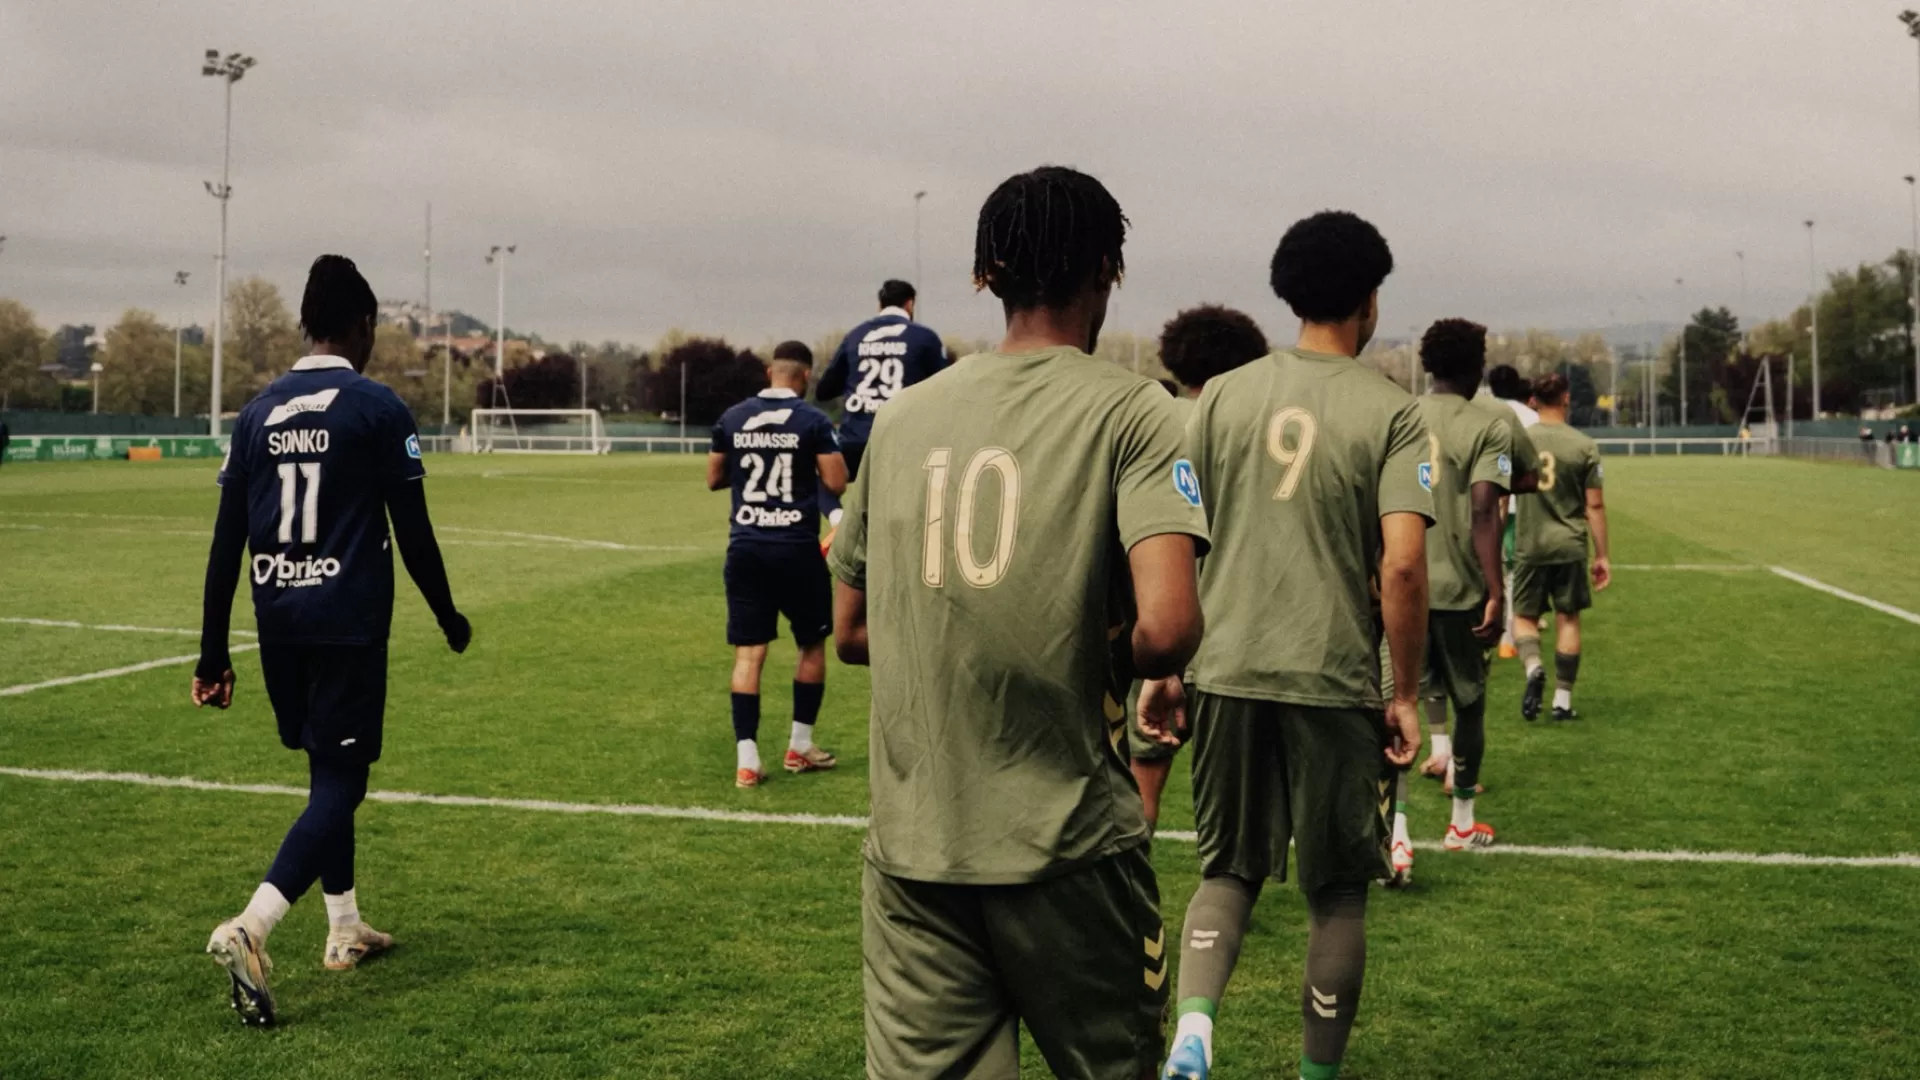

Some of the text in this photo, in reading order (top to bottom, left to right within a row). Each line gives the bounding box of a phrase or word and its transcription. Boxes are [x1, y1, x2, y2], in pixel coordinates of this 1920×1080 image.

[856, 358, 904, 398] 29
[268, 429, 330, 455] SONKO
[733, 432, 800, 449] BOUNASSIR
[1267, 407, 1317, 500] 9
[740, 452, 794, 503] 24
[1538, 451, 1556, 490] 3
[277, 462, 321, 544] 11
[922, 446, 1022, 589] 10
[253, 552, 341, 585] O'brico
